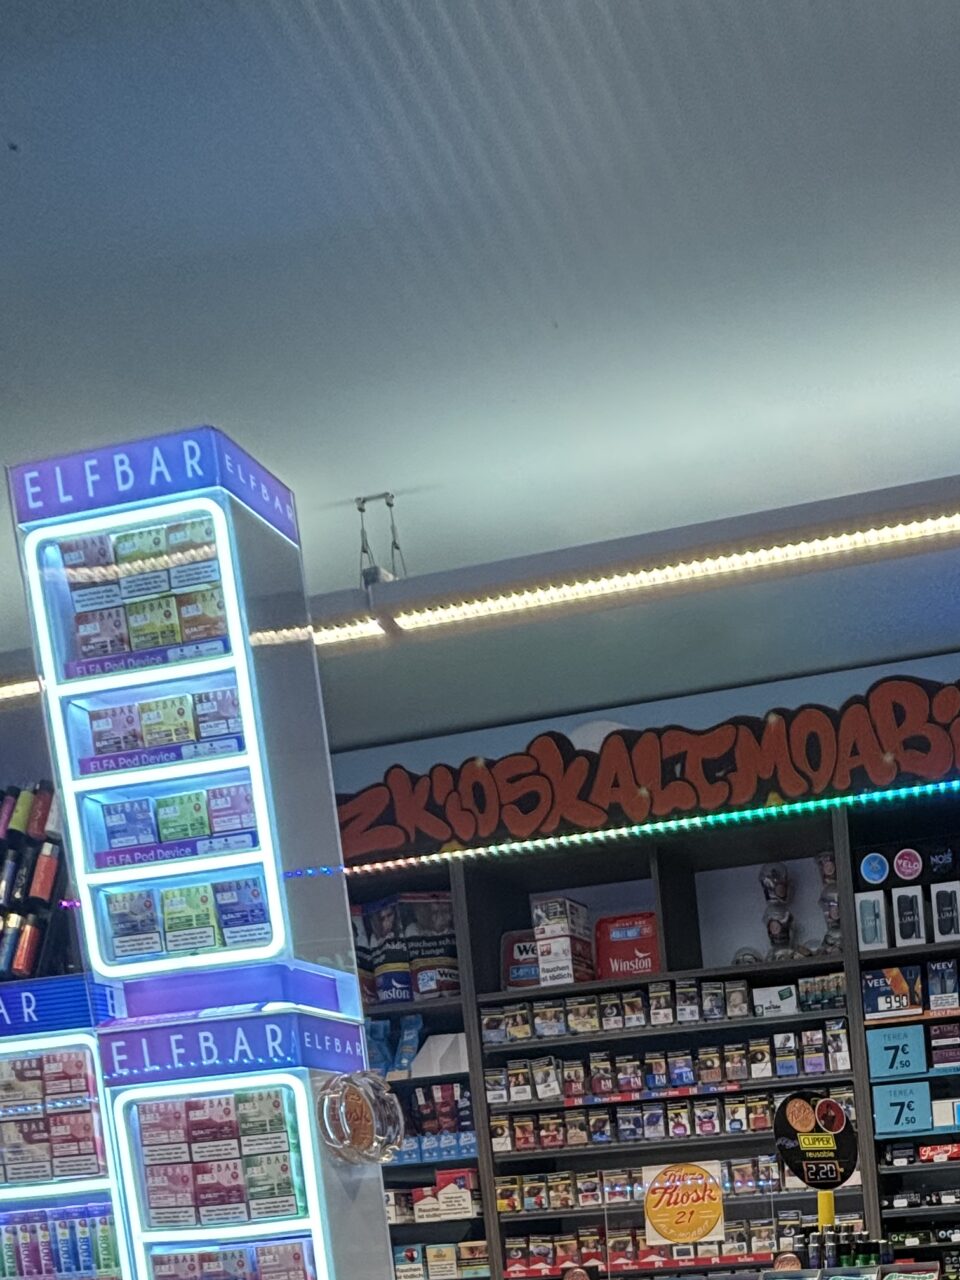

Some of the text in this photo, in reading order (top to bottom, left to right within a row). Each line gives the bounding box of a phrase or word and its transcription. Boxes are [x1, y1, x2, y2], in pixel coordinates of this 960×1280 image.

[24, 439, 204, 510] ELFBAR
[225, 453, 295, 523] ELFBAR
[105, 659, 126, 673] Pod
[127, 654, 163, 670] Device
[90, 749, 177, 773] ELFA Pod Device
[106, 845, 193, 867] ELFA Pod Device
[897, 858, 920, 870] VELO
[609, 954, 653, 974] Winston
[930, 961, 954, 971] VEEV
[867, 977, 893, 989] VEEV
[304, 1031, 363, 1058] ELFBAR
[883, 1033, 909, 1042] TEREA
[112, 1023, 284, 1075] ELFBAR
[888, 1089, 914, 1098] TEREA
[801, 1135, 834, 1148] CLIPPER
[806, 1149, 835, 1159] reusable
[807, 1162, 836, 1179] 2,20
[650, 1182, 718, 1210] Kiosk
[674, 1210, 694, 1225] 21
